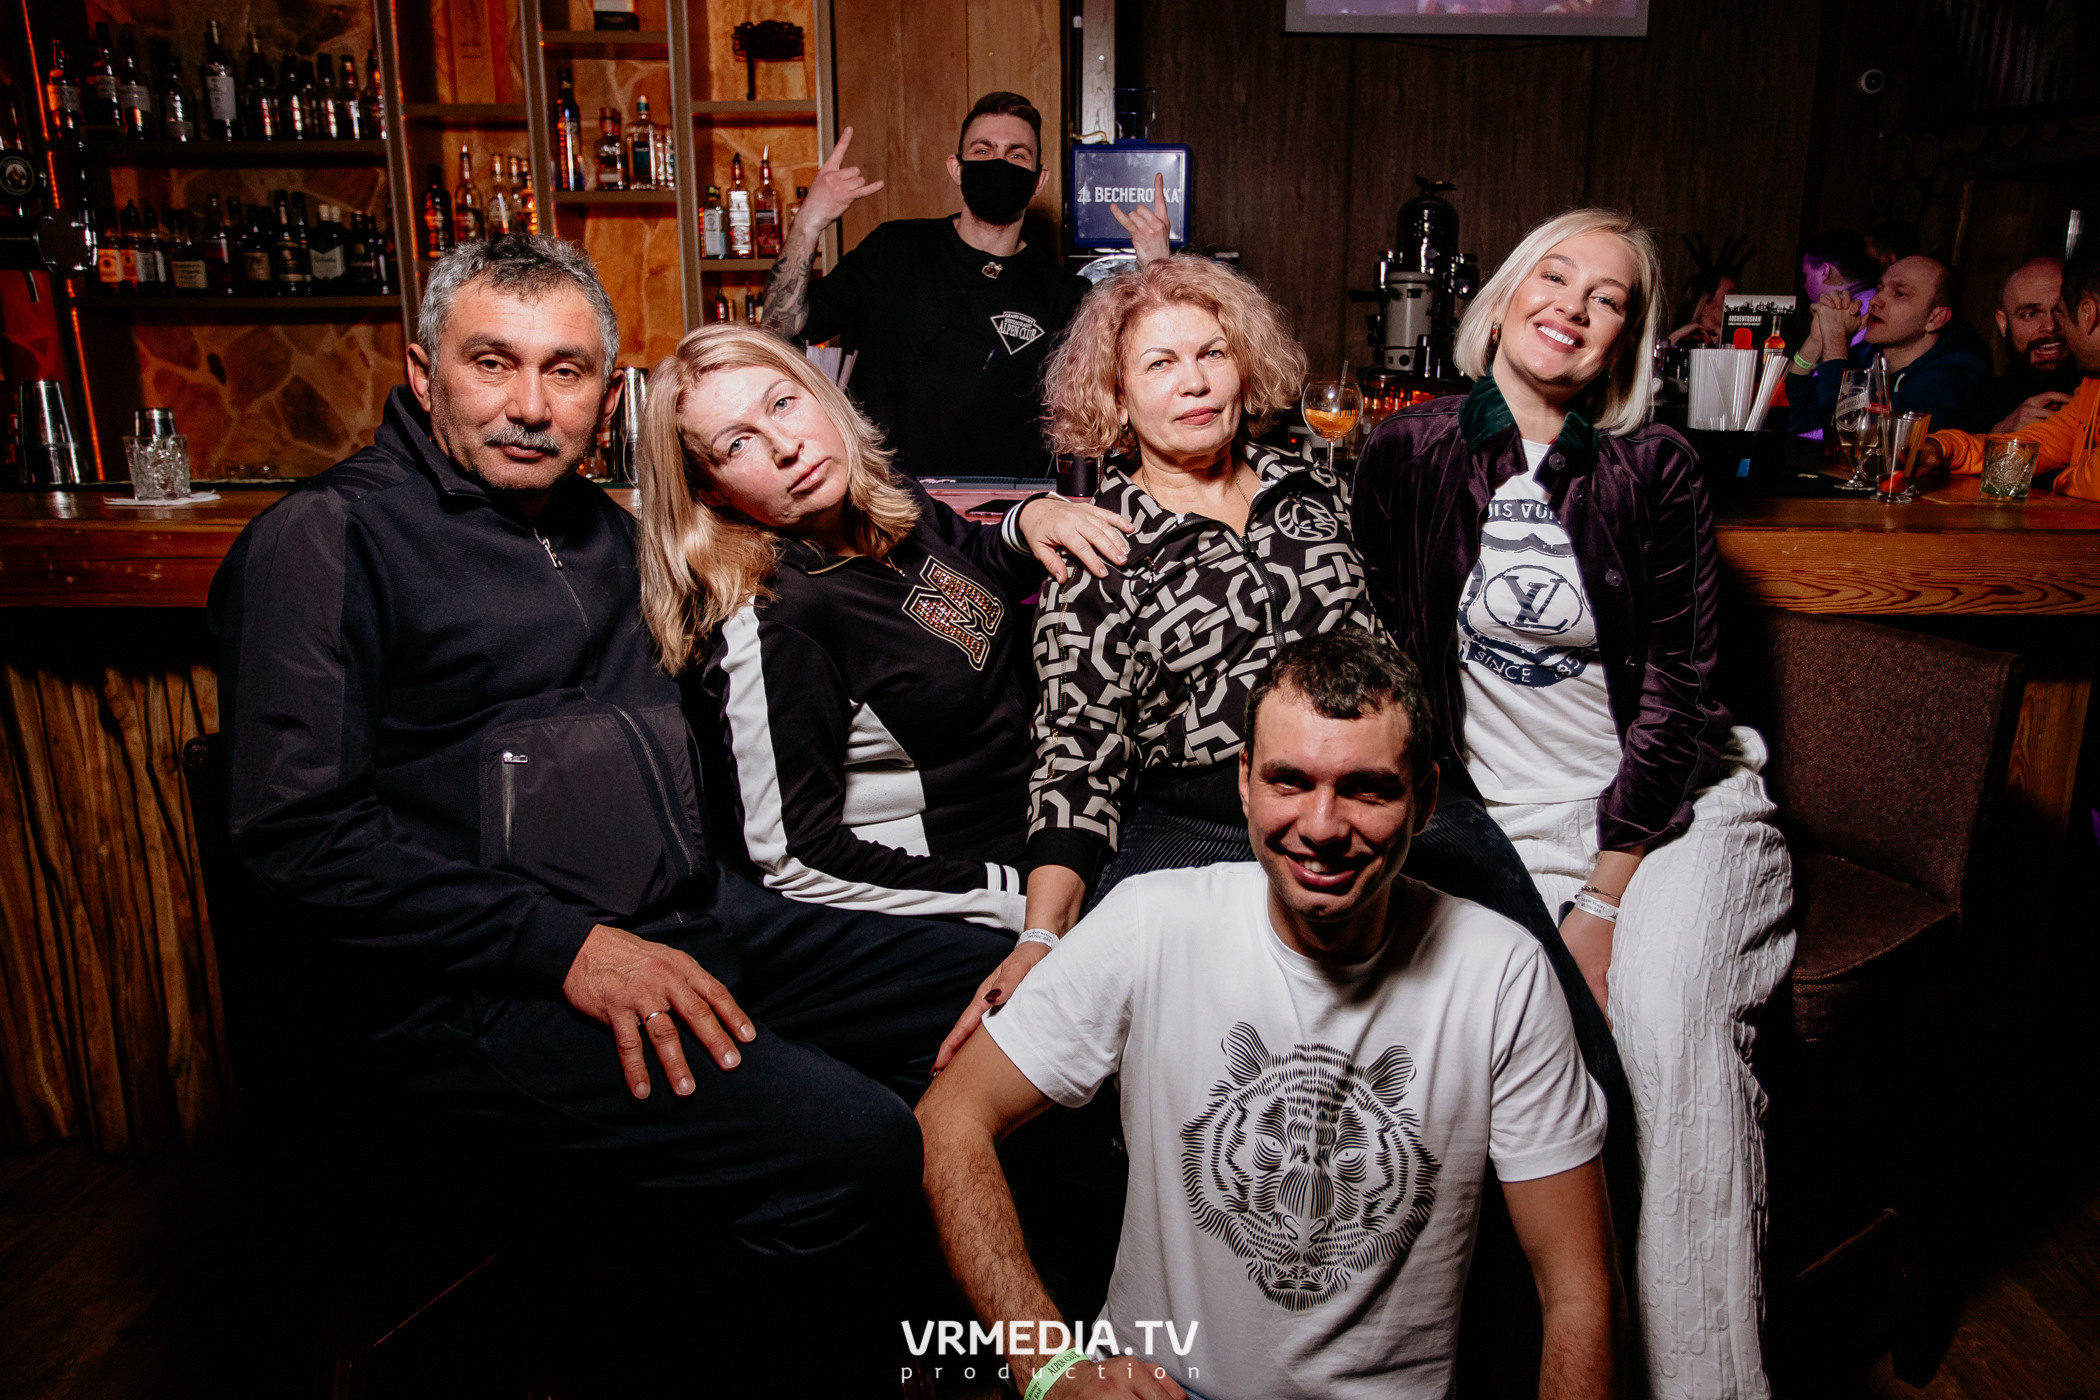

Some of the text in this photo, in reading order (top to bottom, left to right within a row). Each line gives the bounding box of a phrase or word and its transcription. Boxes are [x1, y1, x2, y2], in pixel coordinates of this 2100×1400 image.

[1094, 186, 1180, 203] BECHEROKA
[998, 320, 1019, 337] ALPEN
[1474, 650, 1531, 683] SINCE
